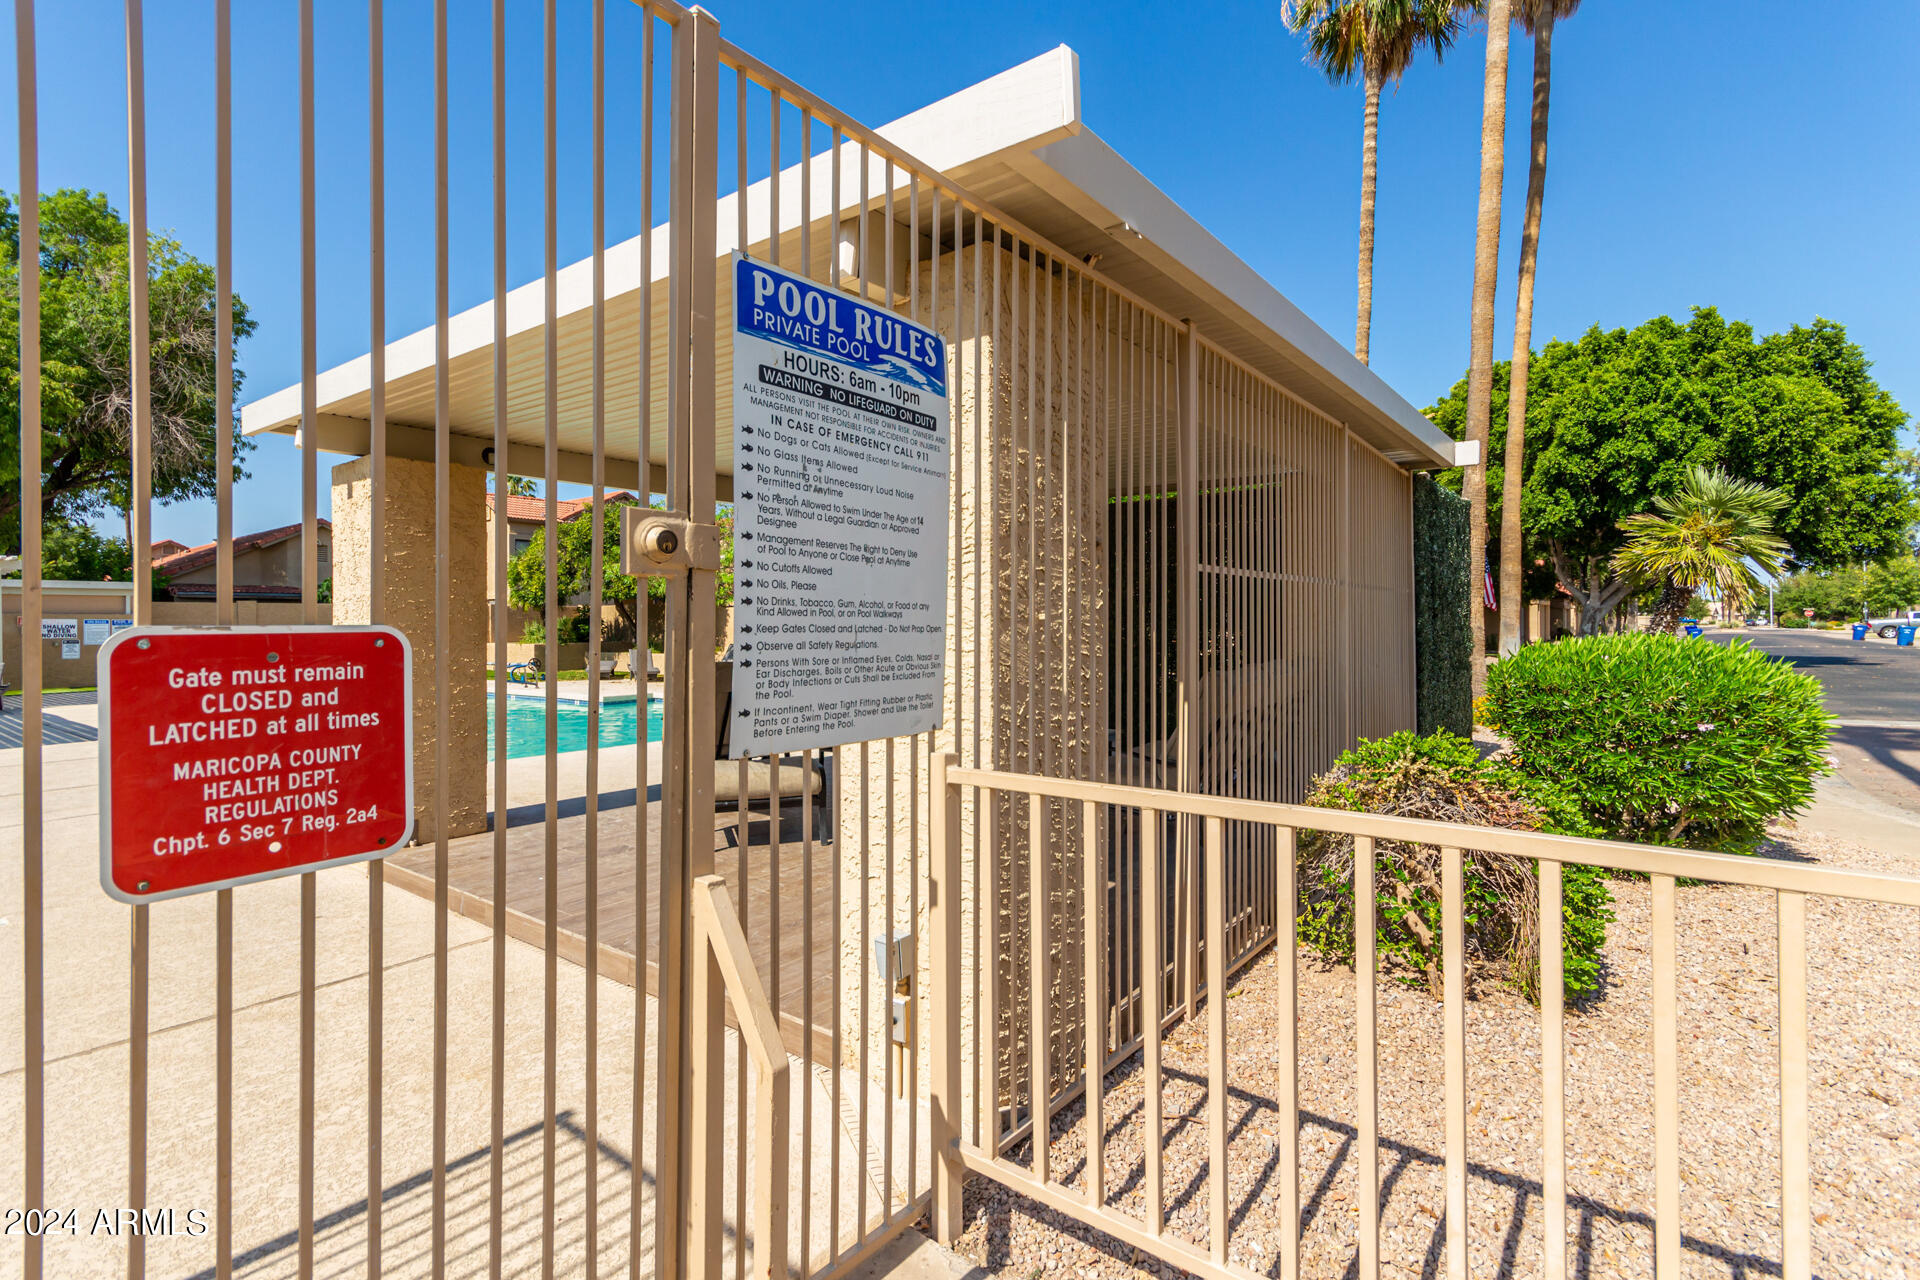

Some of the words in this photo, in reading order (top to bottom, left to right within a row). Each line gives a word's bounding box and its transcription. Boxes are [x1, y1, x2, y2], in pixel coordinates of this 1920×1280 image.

[752, 270, 844, 333] POOL
[854, 308, 937, 368] RULES
[754, 308, 820, 345] PRIVATE
[828, 335, 870, 362] POOL
[784, 350, 844, 384] HOURS:
[850, 370, 876, 393] 6am
[889, 383, 920, 406] 10pm
[743, 382, 757, 393] ALL
[760, 386, 796, 404] PERSONS
[798, 397, 815, 409] VISIT
[818, 402, 829, 413] THE
[832, 406, 851, 419] POOL
[750, 396, 803, 417] MANAGEMENT
[805, 410, 819, 421] NOT
[763, 367, 823, 397] WARNING
[830, 387, 846, 403] NO
[849, 393, 896, 417] LIFEGUARD
[899, 408, 912, 422] ON
[915, 413, 934, 428] DUTY
[757, 427, 771, 439] No
[774, 431, 797, 447] Dogs
[811, 440, 830, 452] Cats
[833, 446, 864, 460] Allowed
[891, 459, 899, 468] for
[771, 414, 782, 427] IN
[787, 418, 814, 434] CASE
[818, 426, 831, 438] OF
[835, 430, 891, 452] EMERGENCY
[893, 445, 913, 458] CALL
[916, 450, 929, 462] 911
[757, 445, 770, 457] No
[774, 448, 798, 462] Glass
[801, 454, 824, 467] Items
[826, 459, 858, 474] Allowed
[757, 463, 770, 474] No
[774, 466, 810, 483] Running
[824, 475, 873, 494] Unnecessary
[876, 485, 893, 496] Loud
[757, 475, 801, 490] Permitted
[803, 483, 812, 492] at
[813, 484, 843, 499] Anytime
[757, 492, 770, 502] No
[772, 494, 798, 506] Person
[800, 498, 831, 511] Allowed
[833, 504, 840, 513] to
[842, 505, 860, 516] Swim
[862, 508, 882, 519] Under
[884, 511, 894, 521] The
[917, 516, 924, 525] 14
[785, 508, 815, 520] Without
[824, 513, 845, 526] Legal
[846, 516, 879, 528] Guardian
[757, 515, 797, 530] Designee
[757, 532, 814, 549] Management
[815, 539, 848, 550] Reserves
[850, 543, 862, 552] The
[882, 546, 888, 555] to
[757, 544, 766, 554] of
[768, 545, 786, 555] Pool
[788, 547, 796, 556] to
[798, 548, 828, 561] Anyone
[839, 552, 859, 562] Close
[877, 556, 884, 564] at
[757, 562, 769, 571] No
[771, 563, 800, 573] Cutoffs
[802, 565, 832, 575] Allowed
[756, 579, 769, 588] No
[790, 581, 817, 590] Please
[756, 596, 769, 605] No
[756, 607, 775, 616] Kind
[777, 607, 808, 616] Allowed
[810, 608, 816, 616] in
[857, 609, 871, 617] Pool
[756, 624, 779, 635] Keep
[782, 624, 806, 633] Gates
[808, 624, 836, 632] Closed
[837, 624, 853, 632] and
[854, 624, 882, 632] Latched
[756, 641, 793, 650] Observe
[796, 641, 806, 650] all
[808, 641, 832, 651] Safety
[835, 640, 879, 651] Regulations.
[756, 658, 789, 668] Persons
[792, 657, 810, 666] With
[812, 657, 829, 666] Sore
[842, 655, 874, 664] Inflamed
[756, 670, 770, 679] Ear
[825, 666, 842, 675] Boils
[854, 665, 874, 673] Other
[875, 664, 895, 672] Acute
[169, 668, 222, 689] Gate
[232, 665, 286, 685] must
[295, 662, 364, 682] remain
[768, 679, 790, 691] Body
[792, 676, 832, 687] Infections
[844, 675, 860, 683] Cuts
[862, 674, 880, 682] Shall
[201, 690, 292, 714] CLOSED
[301, 687, 339, 706] and
[754, 708, 760, 717] If
[818, 701, 837, 711] Wear
[840, 699, 857, 710] Tight
[859, 697, 880, 708] Fitting
[756, 690, 770, 700] the
[149, 718, 257, 746] LATCHED
[267, 715, 287, 735] at
[295, 713, 319, 733] all
[327, 711, 380, 730] times
[754, 717, 778, 728] Pants
[801, 712, 821, 723] Swim
[853, 707, 879, 717] Shower
[881, 705, 894, 714] and
[753, 726, 782, 738] Before
[785, 722, 820, 736] Entering
[822, 720, 835, 730] the
[173, 753, 281, 781] MARICOPA
[289, 744, 362, 767] COUNTY
[203, 775, 279, 801] HEALTH
[288, 768, 339, 790] DEPT.
[205, 790, 338, 824] REGULATIONS
[153, 832, 209, 856] Chpt.
[218, 831, 231, 845] 6
[240, 824, 275, 841] Sec
[282, 818, 293, 835] 7
[302, 813, 340, 833] Reg.
[346, 805, 378, 825] 2a4
